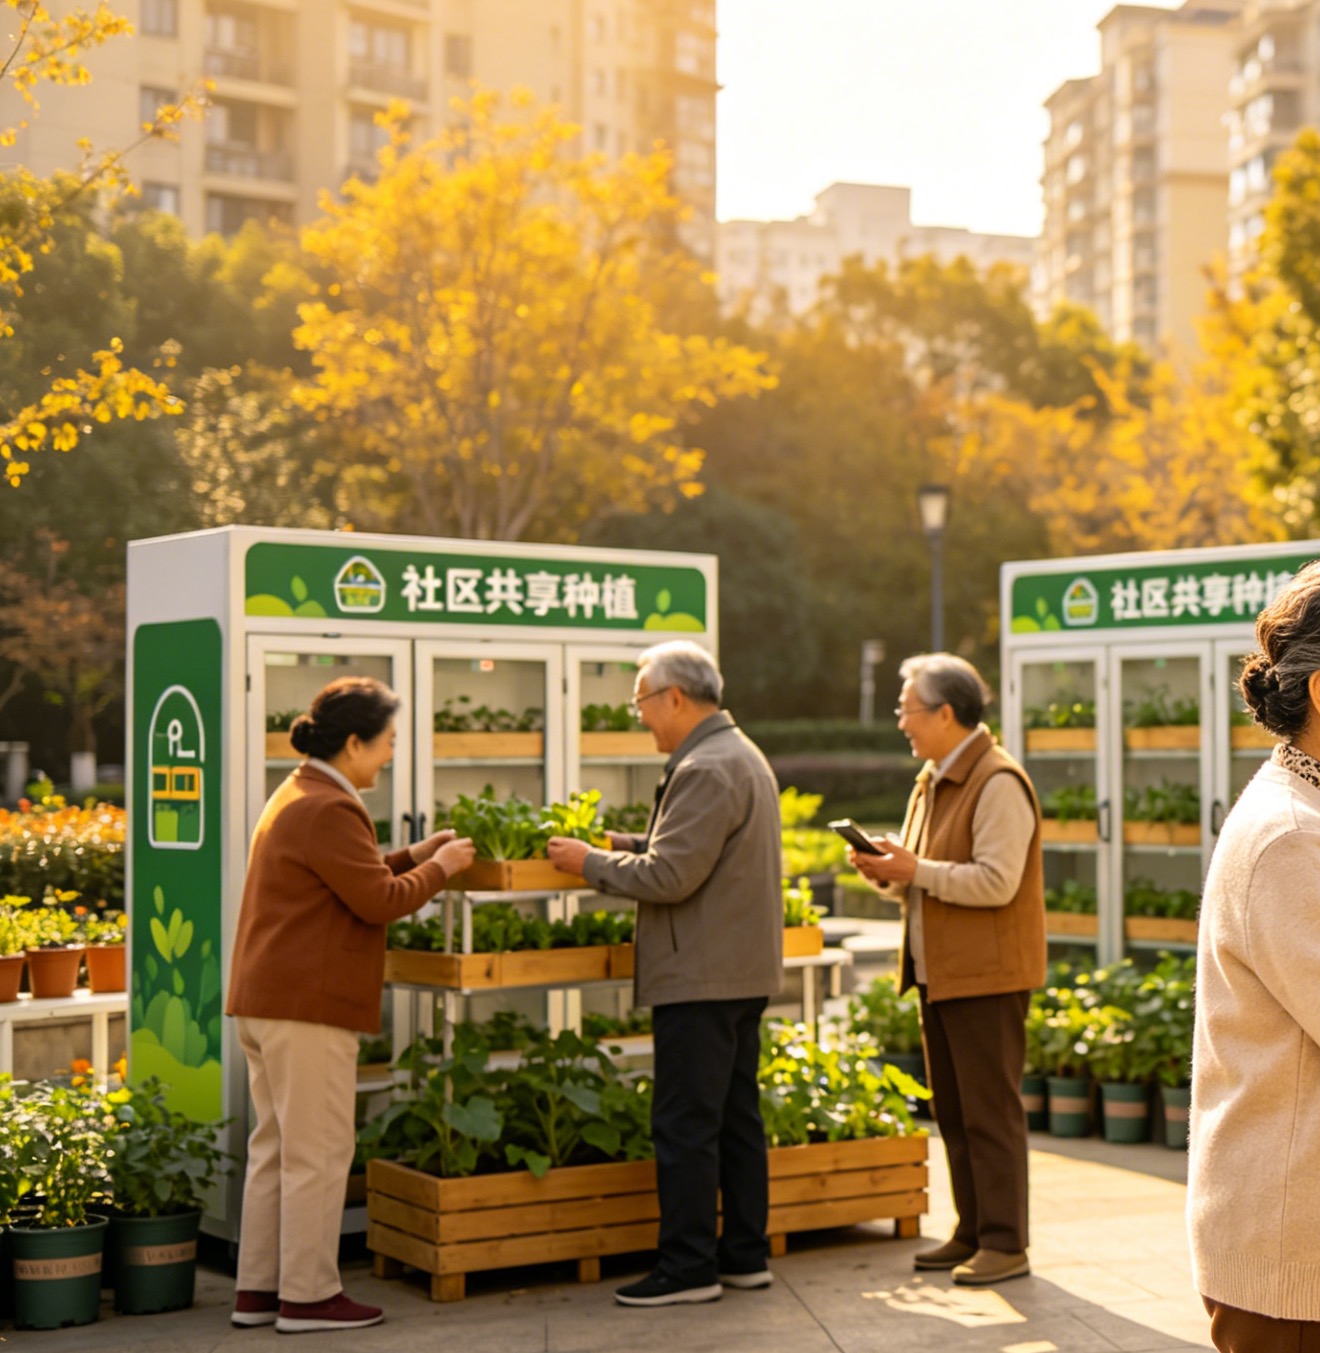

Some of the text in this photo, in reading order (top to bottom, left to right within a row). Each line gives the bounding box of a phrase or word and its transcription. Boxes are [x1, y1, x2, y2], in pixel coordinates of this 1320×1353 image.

[401, 564, 639, 620] 社区共享种植
